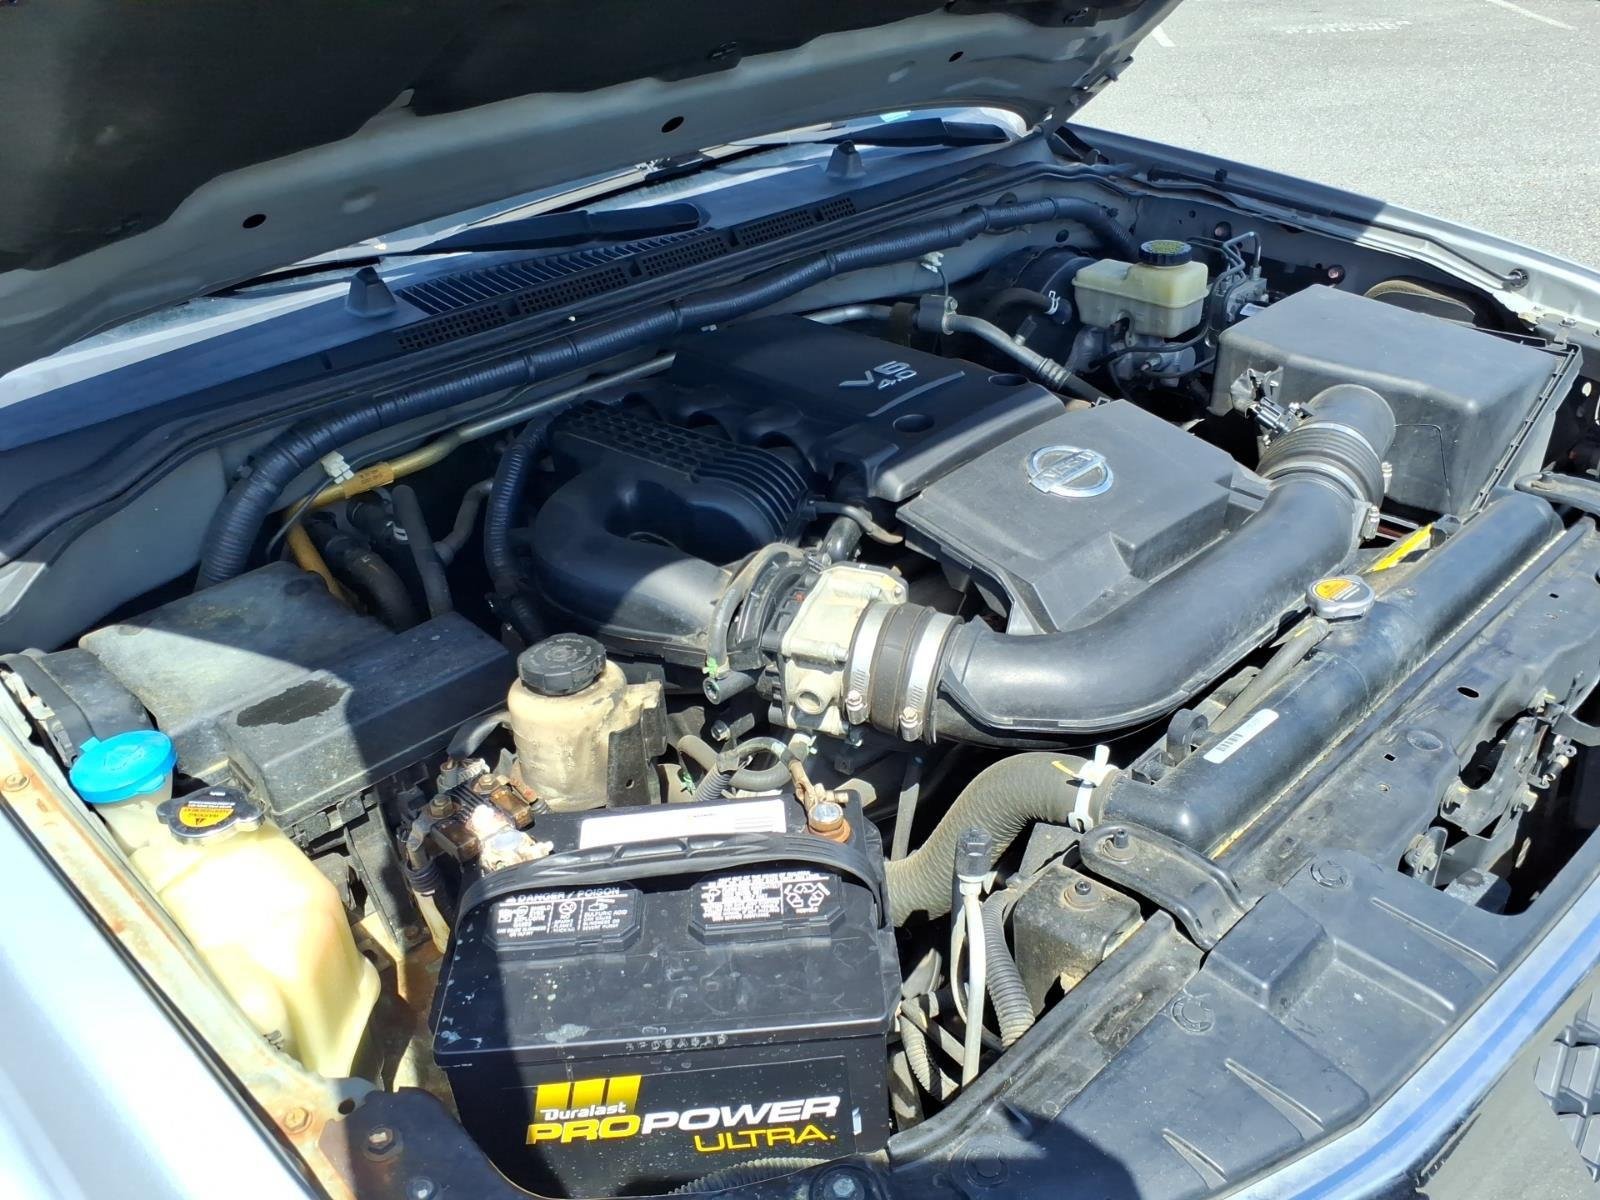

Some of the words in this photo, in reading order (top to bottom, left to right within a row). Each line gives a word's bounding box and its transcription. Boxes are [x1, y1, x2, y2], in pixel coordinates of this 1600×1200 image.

[878, 369, 917, 390] 4.0
[517, 892, 566, 902] DANGER
[577, 887, 620, 898] POISON
[540, 1101, 627, 1121] Duralast
